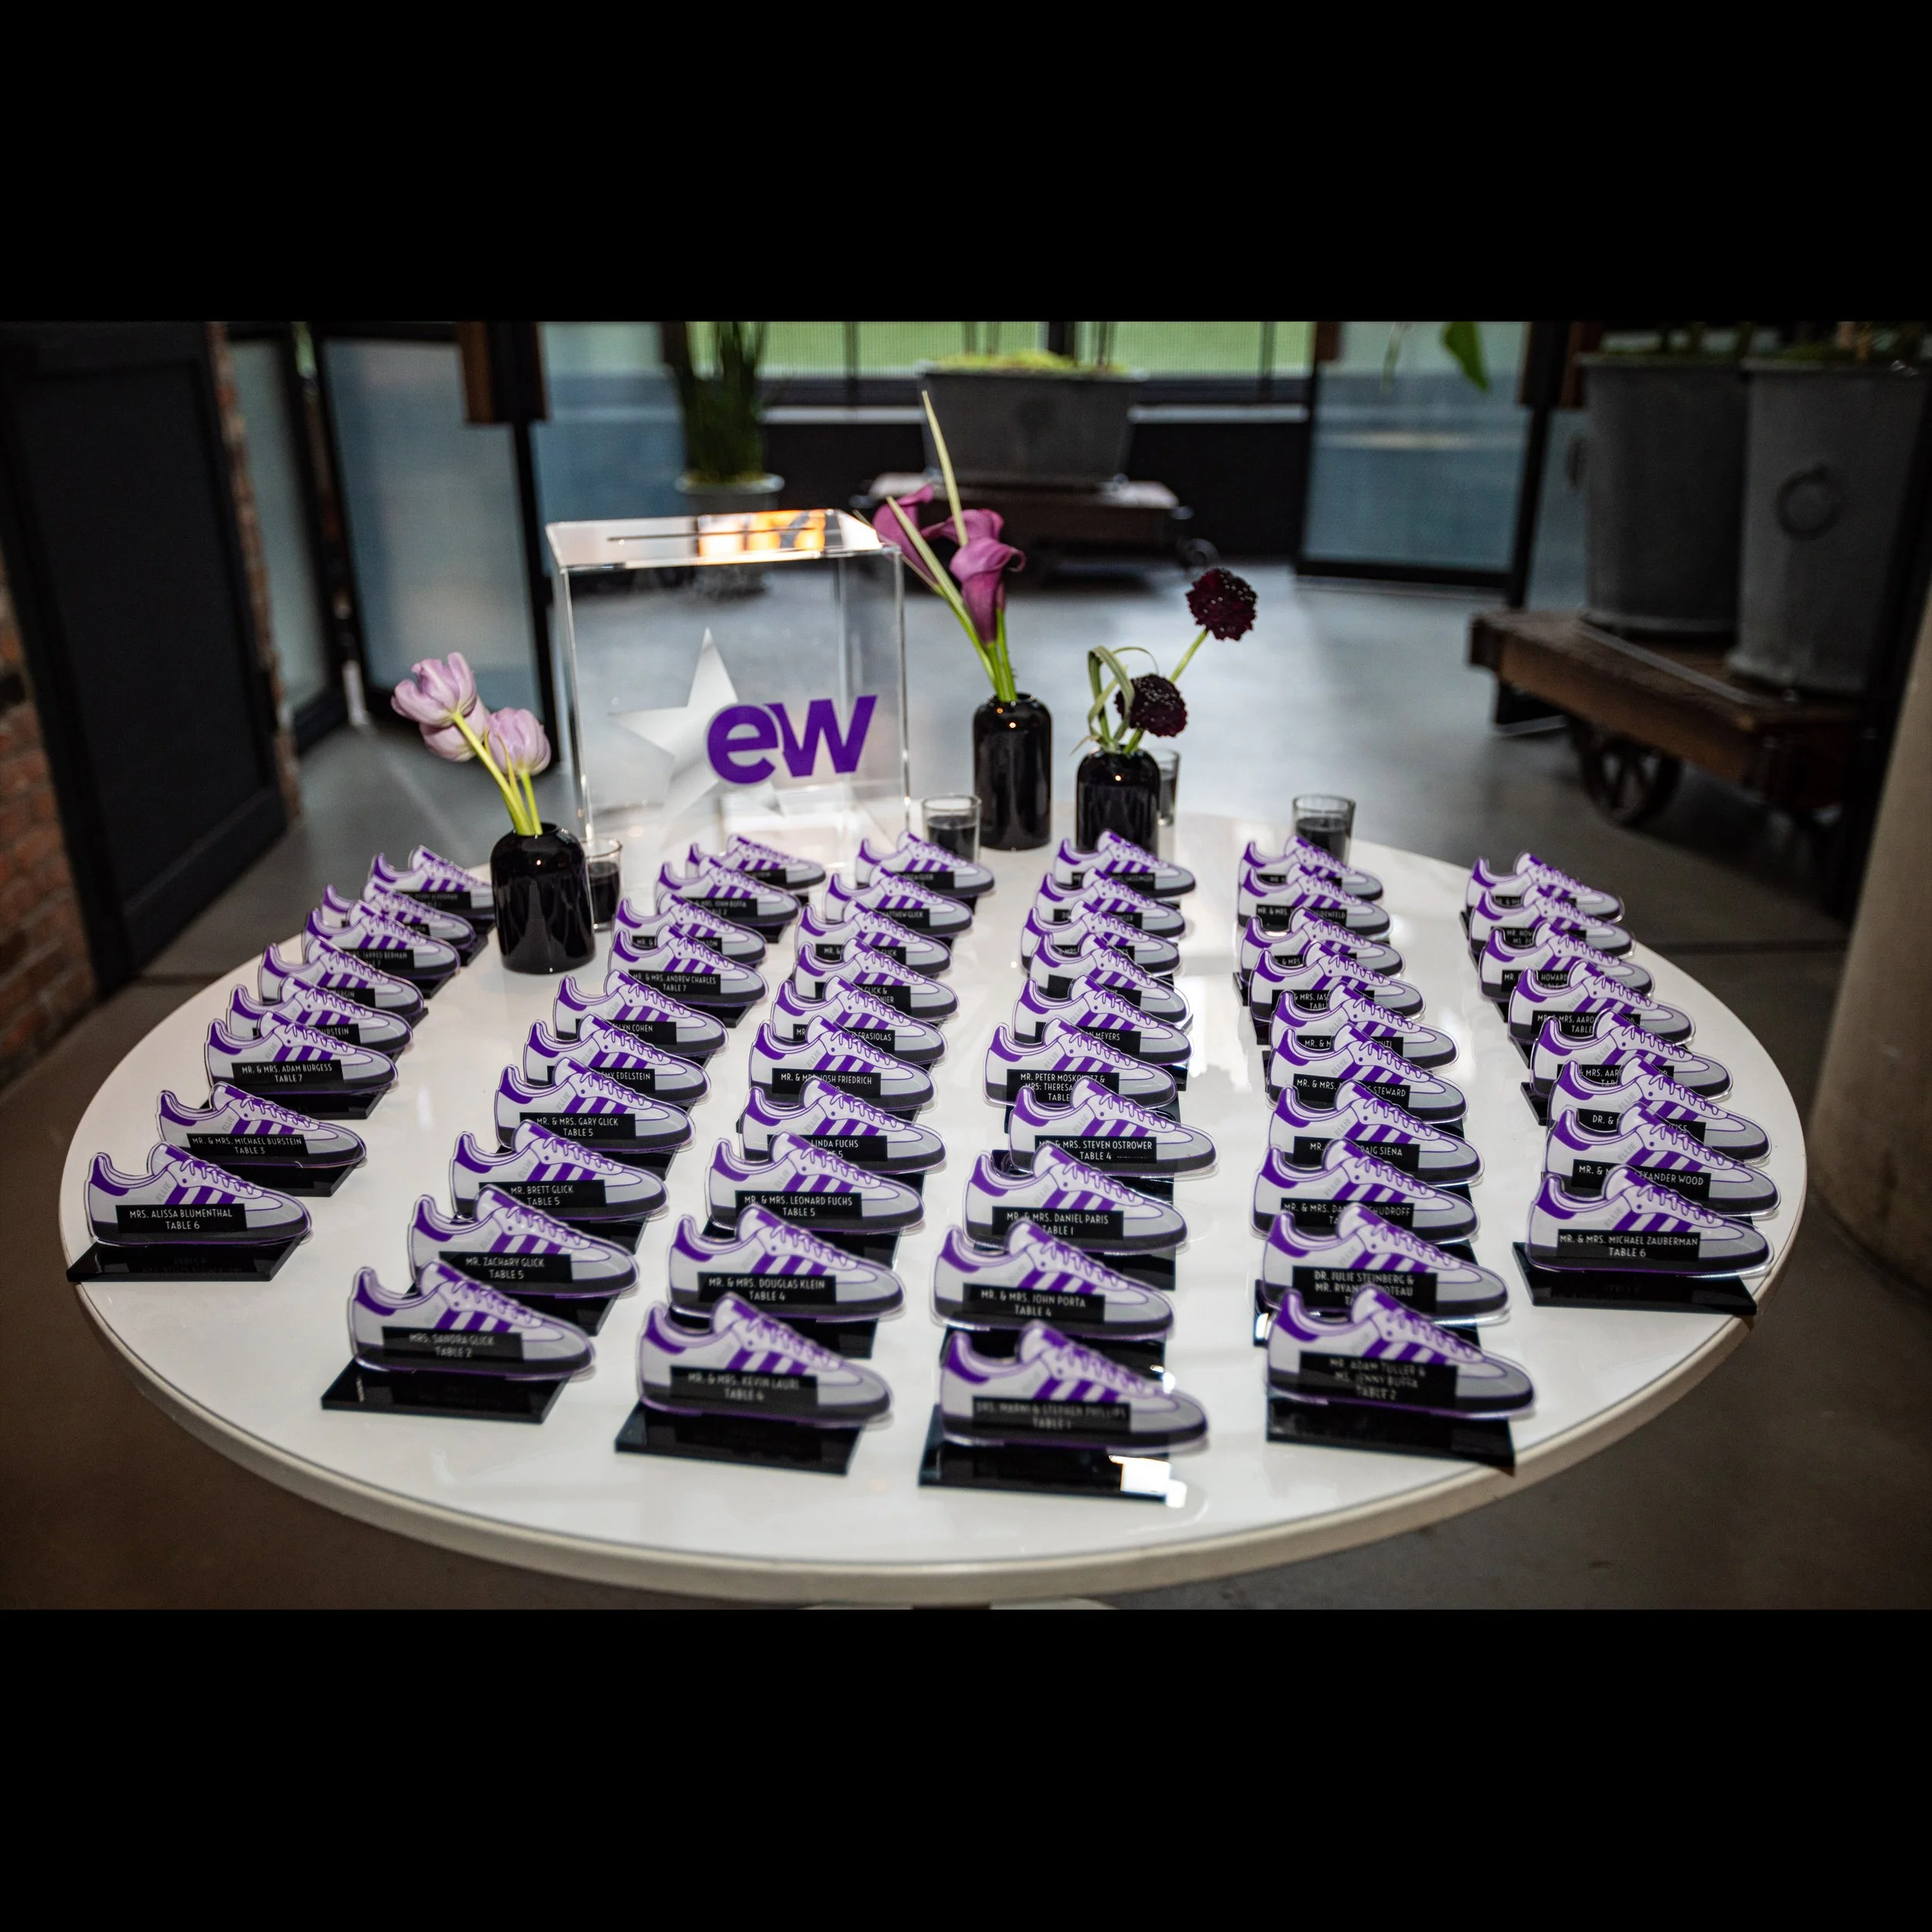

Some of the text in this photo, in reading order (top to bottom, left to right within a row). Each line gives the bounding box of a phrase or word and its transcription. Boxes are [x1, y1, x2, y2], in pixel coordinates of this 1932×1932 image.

[706, 695, 877, 784] ew
[303, 1063, 332, 1073] BURGESS
[838, 1076, 872, 1085] FRIEDRICH
[1320, 1081, 1337, 1090] MRS.
[1374, 1087, 1406, 1097] STEWARD
[1593, 1115, 1614, 1124] DR. &
[811, 1139, 859, 1148] LINDA FUCHS
[1065, 1140, 1082, 1149] MRS.
[1113, 1141, 1152, 1150] OSTROWER
[838, 1150, 844, 1158] 5
[1080, 1151, 1111, 1160] TABLE 4
[1379, 1147, 1403, 1156] SIENA
[1579, 1165, 1594, 1175] MR.
[1679, 1175, 1703, 1185] WOOD
[527, 1185, 550, 1194] BRETT
[526, 1197, 560, 1206] TABLE 5
[790, 1196, 825, 1206] LEONARD
[828, 1197, 852, 1206] FUCHS
[782, 1207, 815, 1216] TABLE 5
[1284, 1202, 1300, 1212] MR.
[1301, 1203, 1308, 1212] &
[1310, 1204, 1329, 1213] MRS.
[130, 1209, 232, 1218] MRS. ALISSA BLUMENTHAL
[1007, 1212, 1109, 1224] MR. MRS. DANIEL PARIS
[166, 1221, 200, 1230] TABLE 6
[1560, 1235, 1698, 1247] MR. & MRS. MICHAEL ZAUBERMAN
[1608, 1247, 1646, 1257] TABLE 6
[466, 1257, 545, 1267] MR. ZACHARY GLICK
[488, 1270, 525, 1279] TABLE 5
[1314, 1270, 1414, 1284] DR. JULIE STEINBERG &
[709, 1278, 825, 1289] MR. & MRS. DOUGLAS KLEIN
[1315, 1283, 1331, 1292] MR.
[749, 1291, 785, 1301] TABLE 4
[981, 1289, 1087, 1308] MR. & MRS. JOHN PORTA
[1015, 1304, 1042, 1317] TABLE
[409, 1334, 430, 1343] MRS.
[468, 1335, 495, 1345] GLICK
[435, 1346, 462, 1357] TABLE
